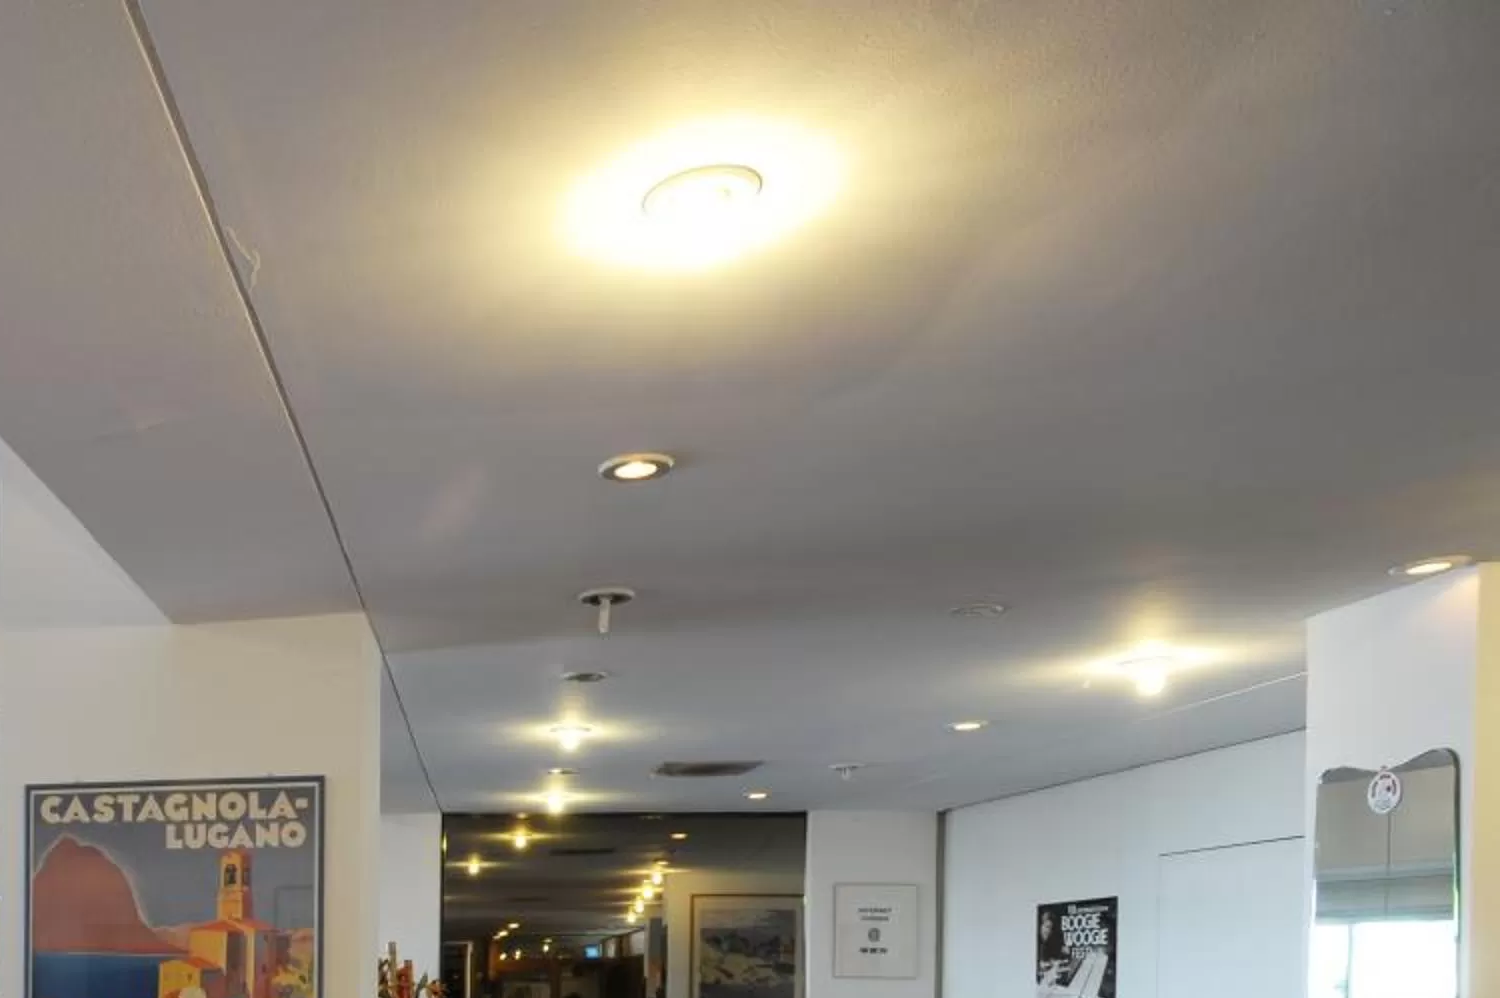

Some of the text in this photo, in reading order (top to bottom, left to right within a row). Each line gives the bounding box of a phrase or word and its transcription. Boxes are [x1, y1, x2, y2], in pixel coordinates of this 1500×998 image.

[165, 822, 307, 849] LUGANO
[1061, 912, 1101, 931] BOOGIE
[1063, 928, 1109, 947] WOOGIE
